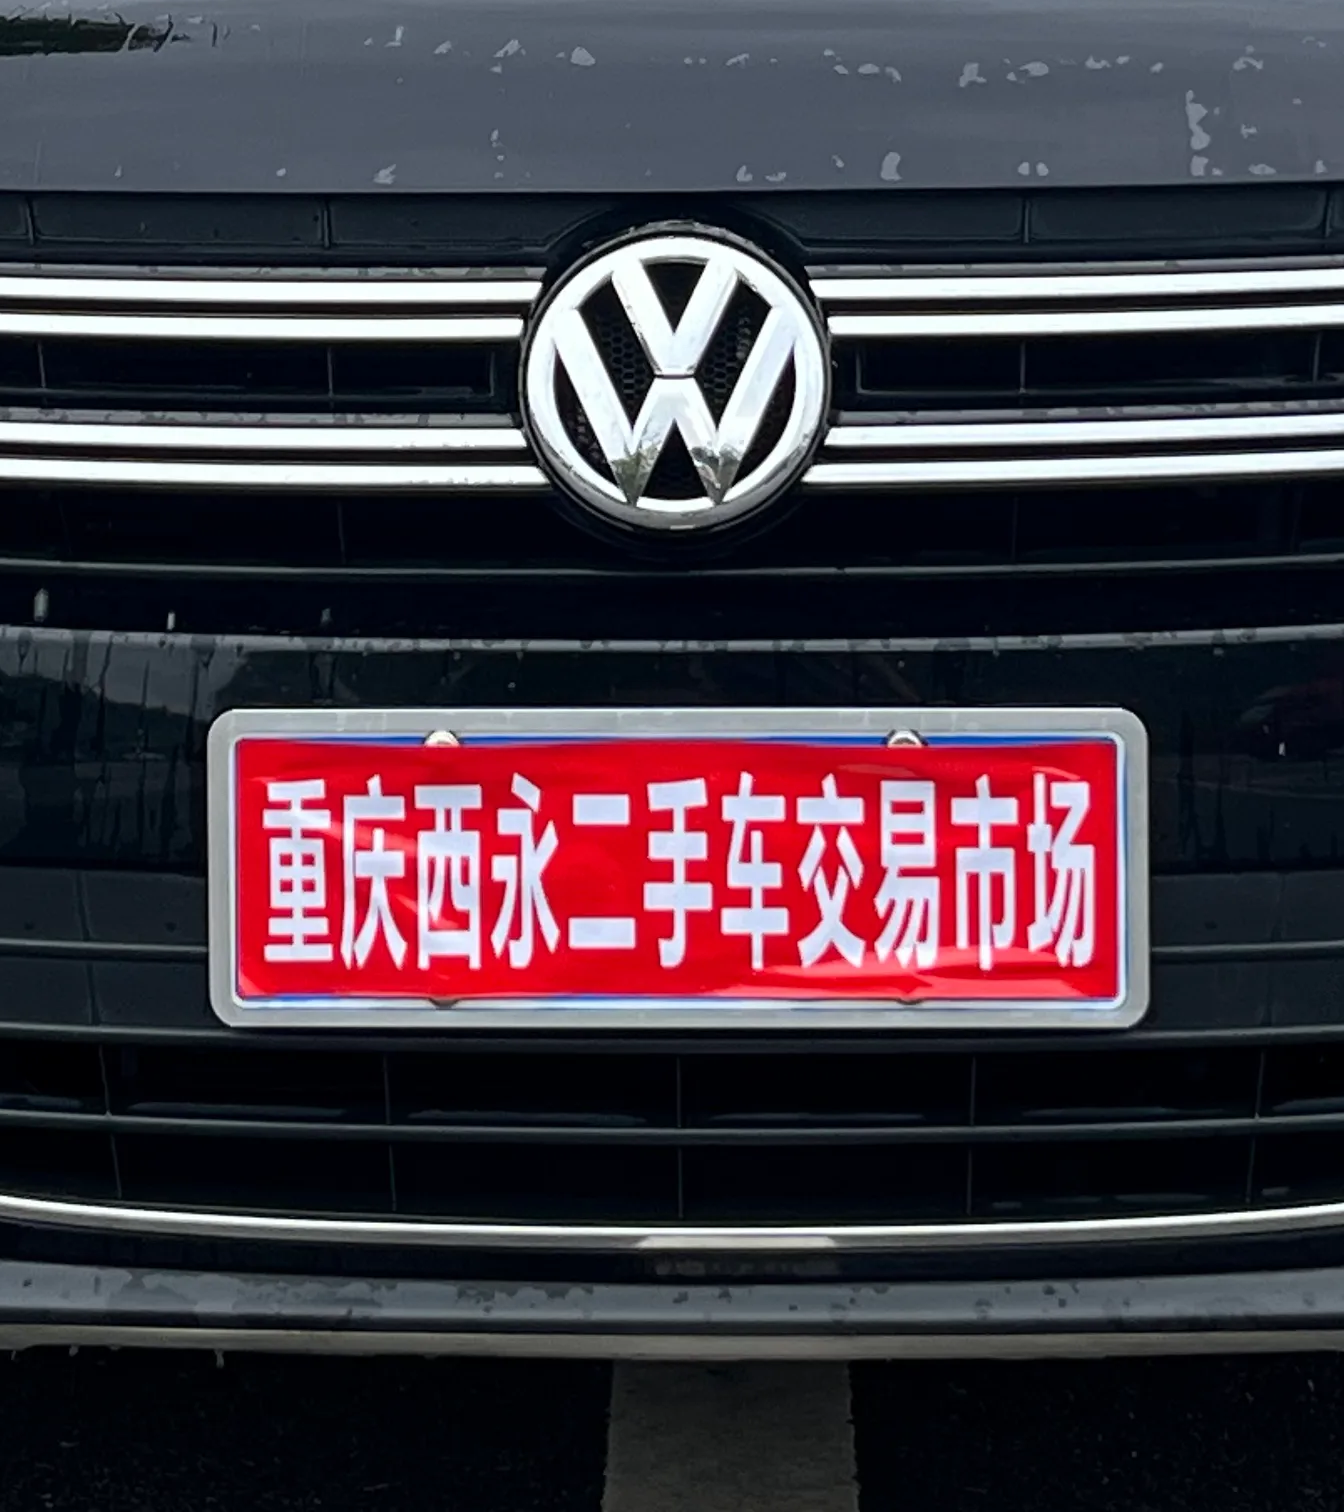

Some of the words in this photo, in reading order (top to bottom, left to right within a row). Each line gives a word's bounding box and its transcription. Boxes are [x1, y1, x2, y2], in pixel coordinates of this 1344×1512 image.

[262, 772, 1095, 971] 重庆西永二手车交易市场
